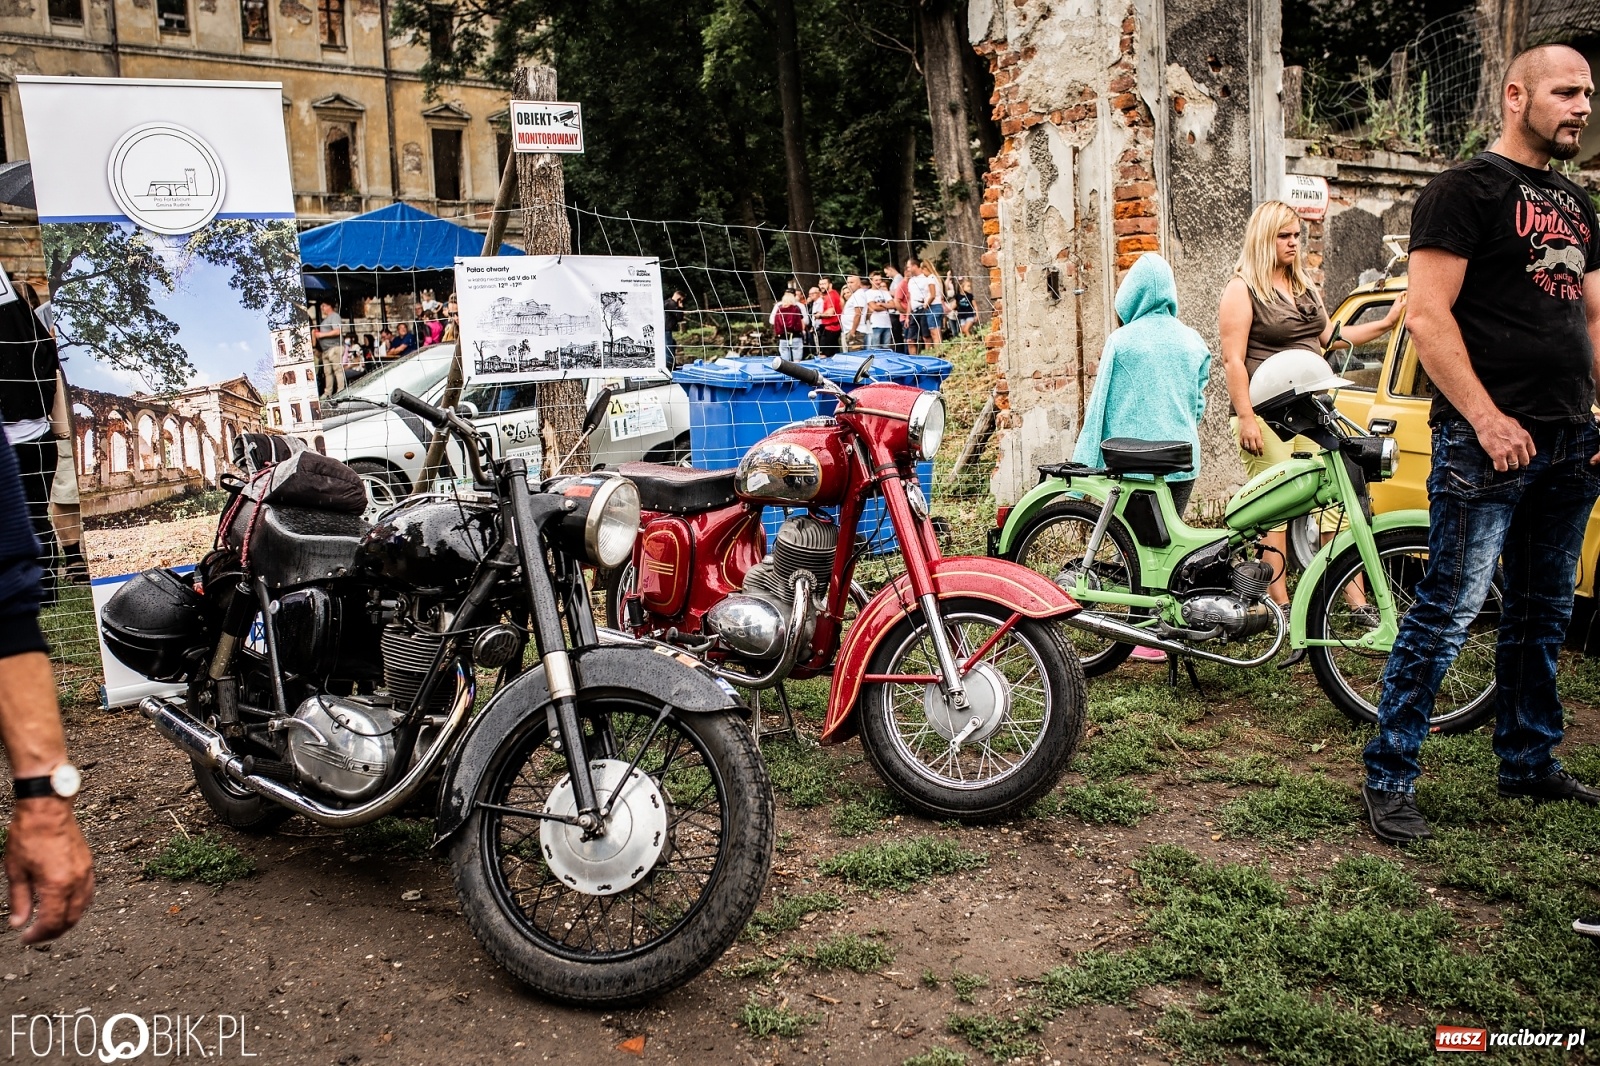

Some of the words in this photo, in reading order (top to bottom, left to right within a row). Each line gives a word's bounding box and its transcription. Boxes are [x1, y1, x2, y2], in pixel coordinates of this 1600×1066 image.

[516, 111, 552, 126] OBIEKT
[518, 132, 578, 146] MONITOROWANY
[1291, 189, 1323, 200] PRYWATNY
[1532, 268, 1557, 297] RIDE
